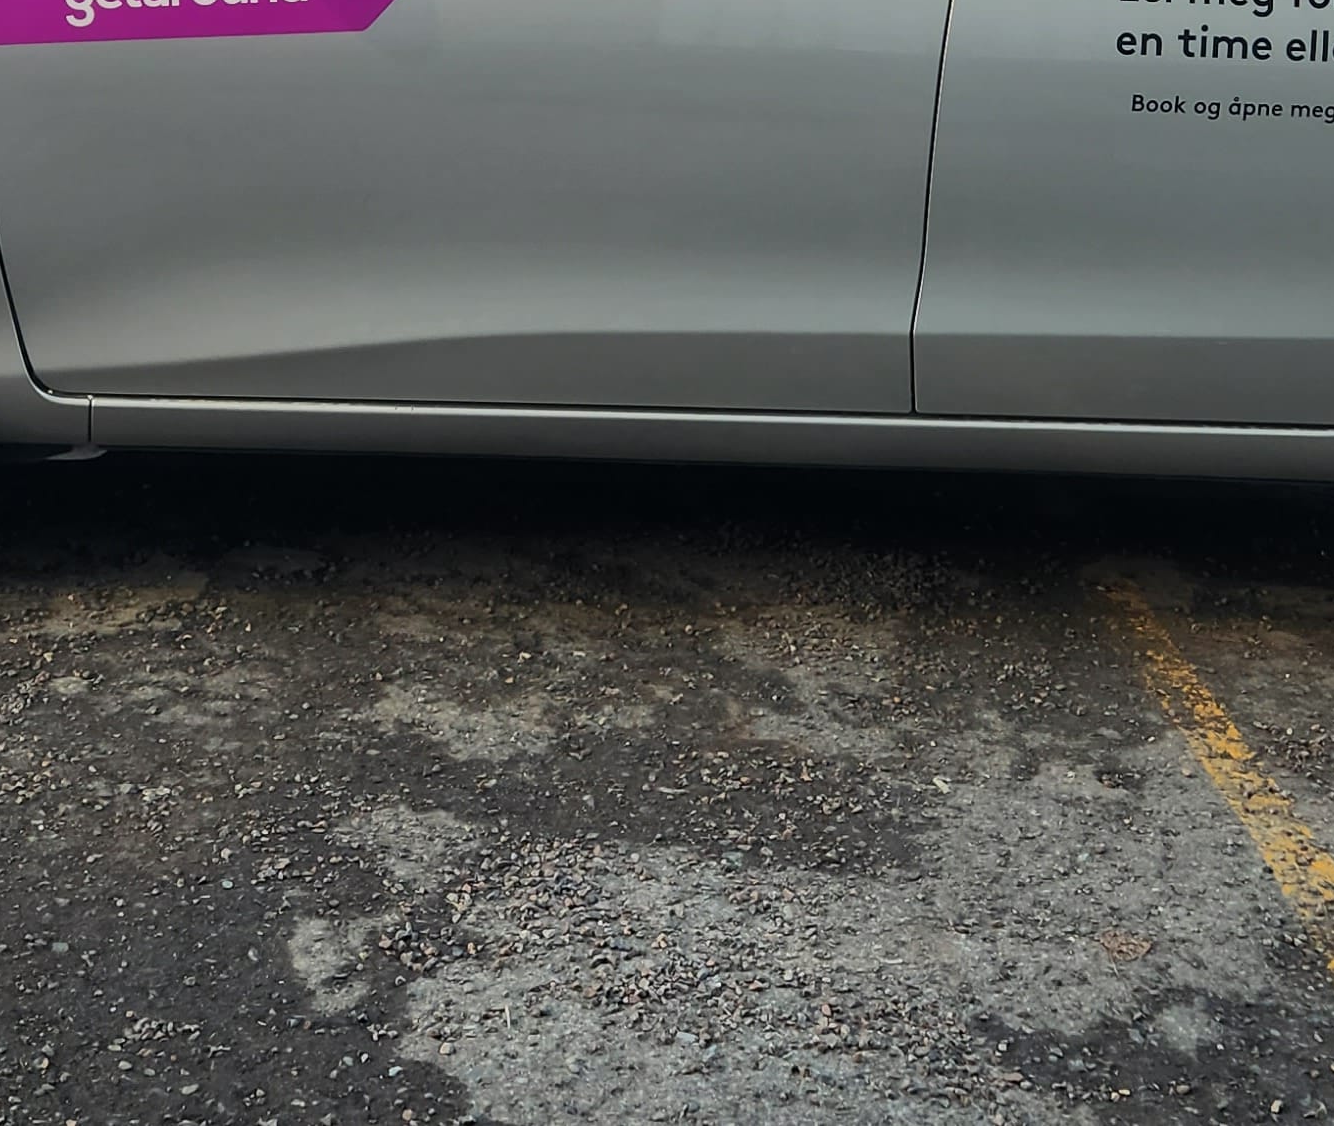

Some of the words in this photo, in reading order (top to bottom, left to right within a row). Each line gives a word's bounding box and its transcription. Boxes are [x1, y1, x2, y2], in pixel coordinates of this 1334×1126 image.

[1116, 31, 1163, 56] en
[1178, 24, 1272, 60] time
[1131, 94, 1187, 114] Book
[1193, 101, 1221, 121] og
[1227, 96, 1284, 122] åpne
